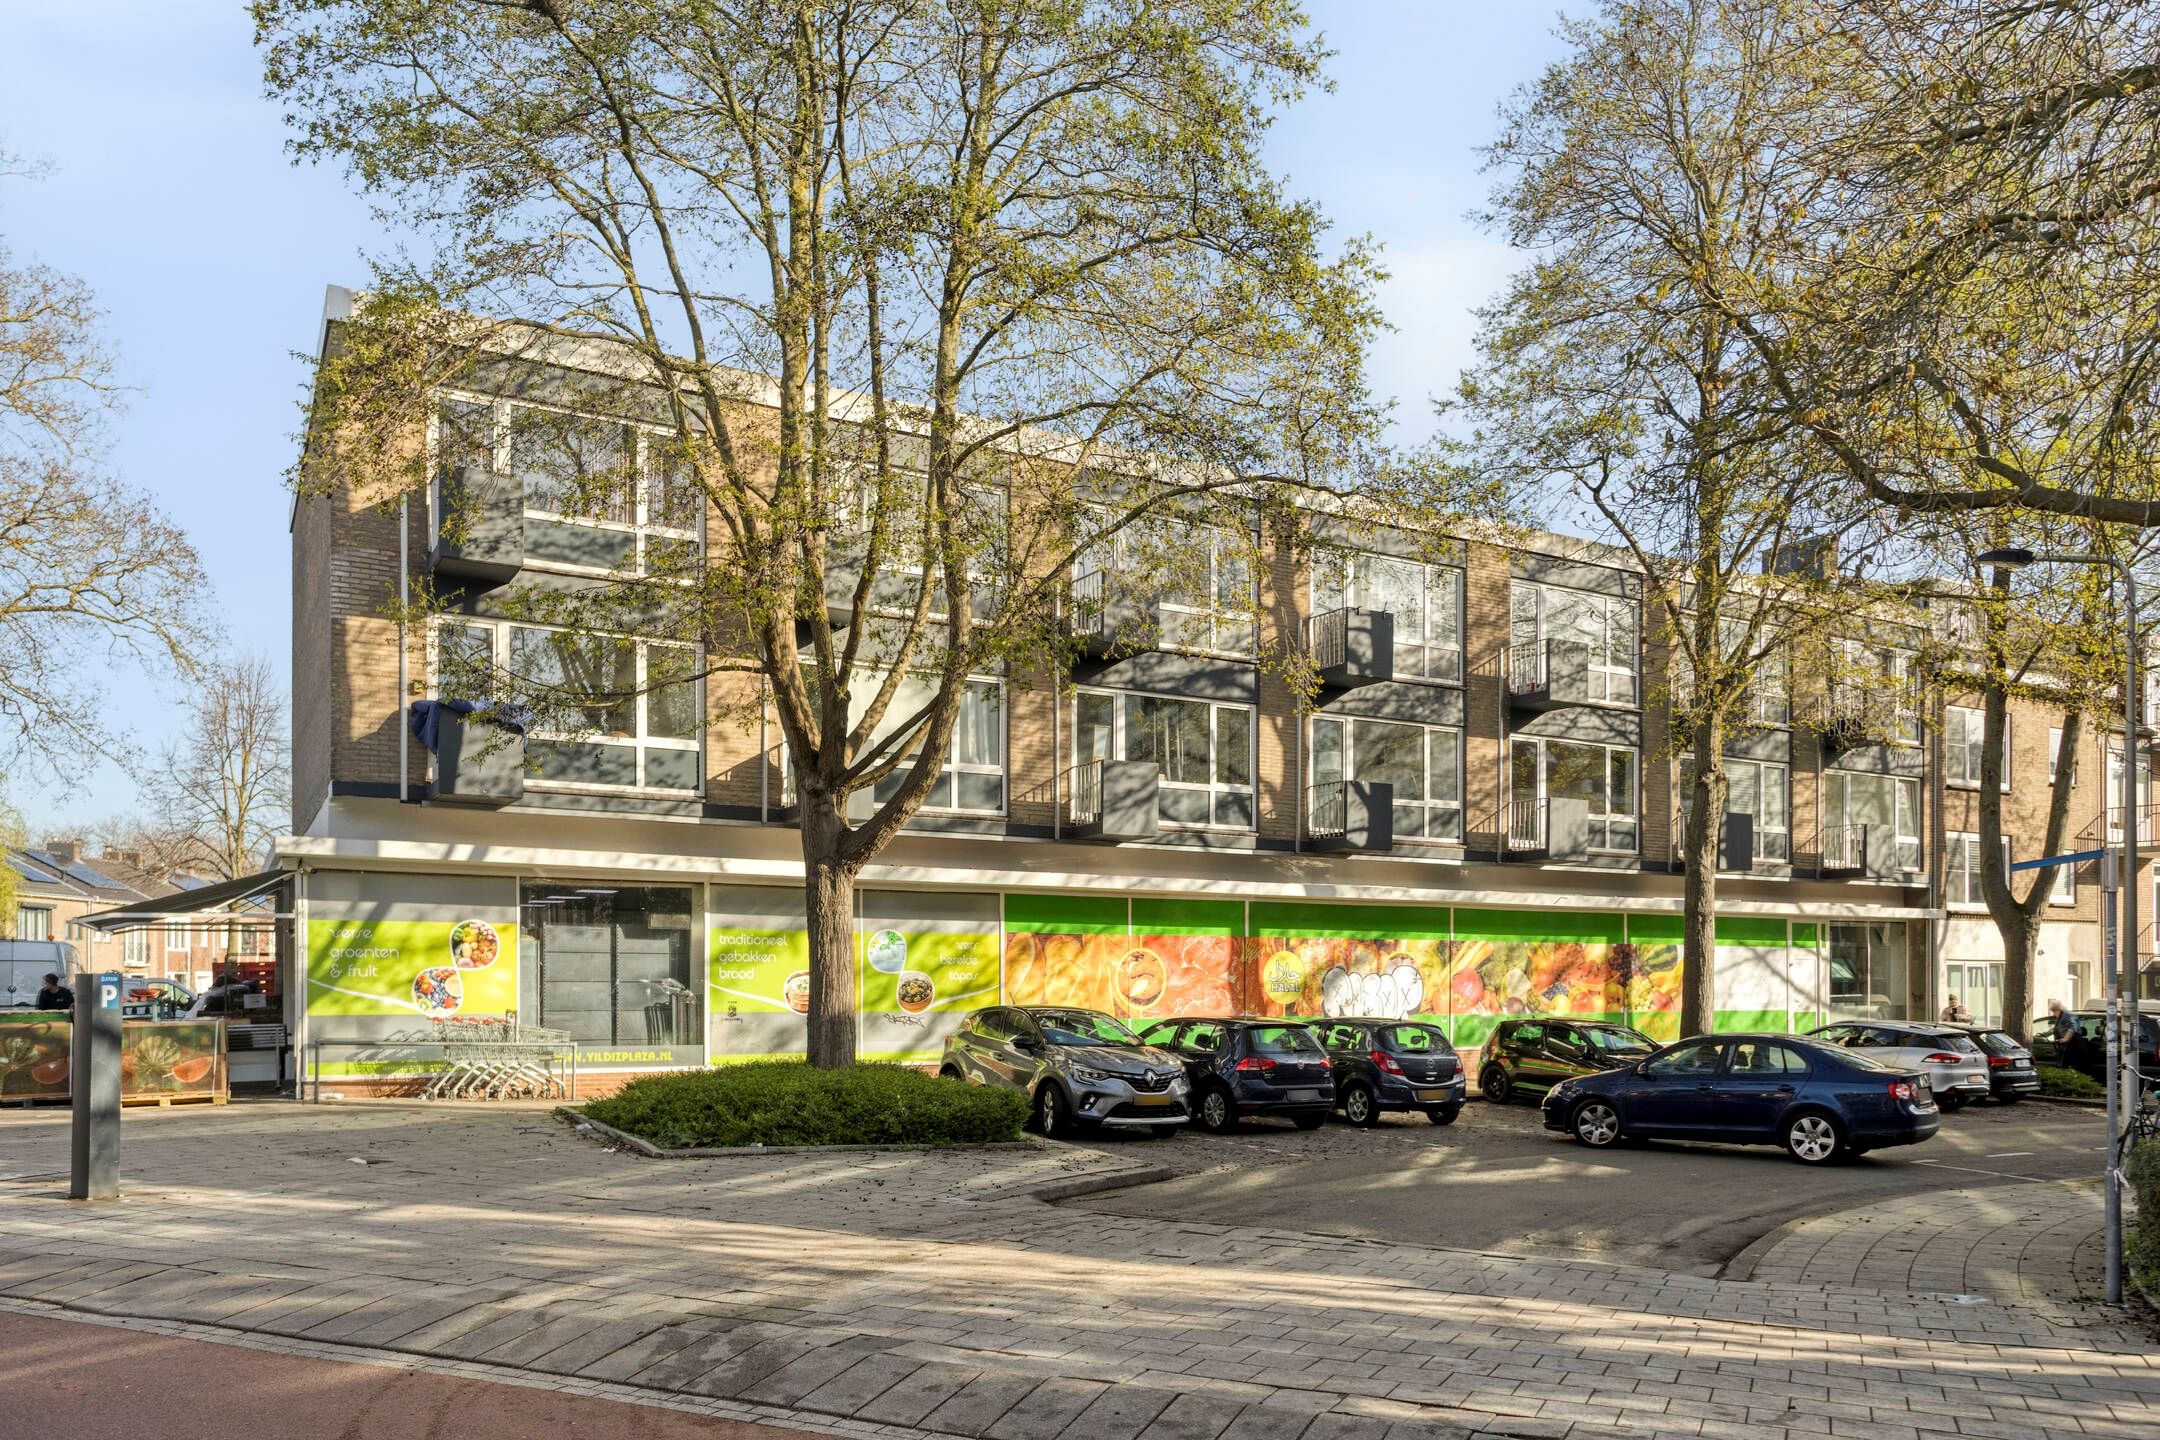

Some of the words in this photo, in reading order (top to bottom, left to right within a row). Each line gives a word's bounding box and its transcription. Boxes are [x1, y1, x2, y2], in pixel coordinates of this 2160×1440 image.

[329, 928, 373, 938] verse
[719, 932, 788, 946] traditioneel
[329, 946, 399, 961] groenten
[719, 950, 777, 965] gebakken
[330, 963, 342, 978] &
[348, 964, 378, 978] fruit
[719, 966, 754, 979] brood
[949, 971, 979, 983] tapas
[1269, 960, 1301, 981] حلال
[101, 985, 117, 1009] P
